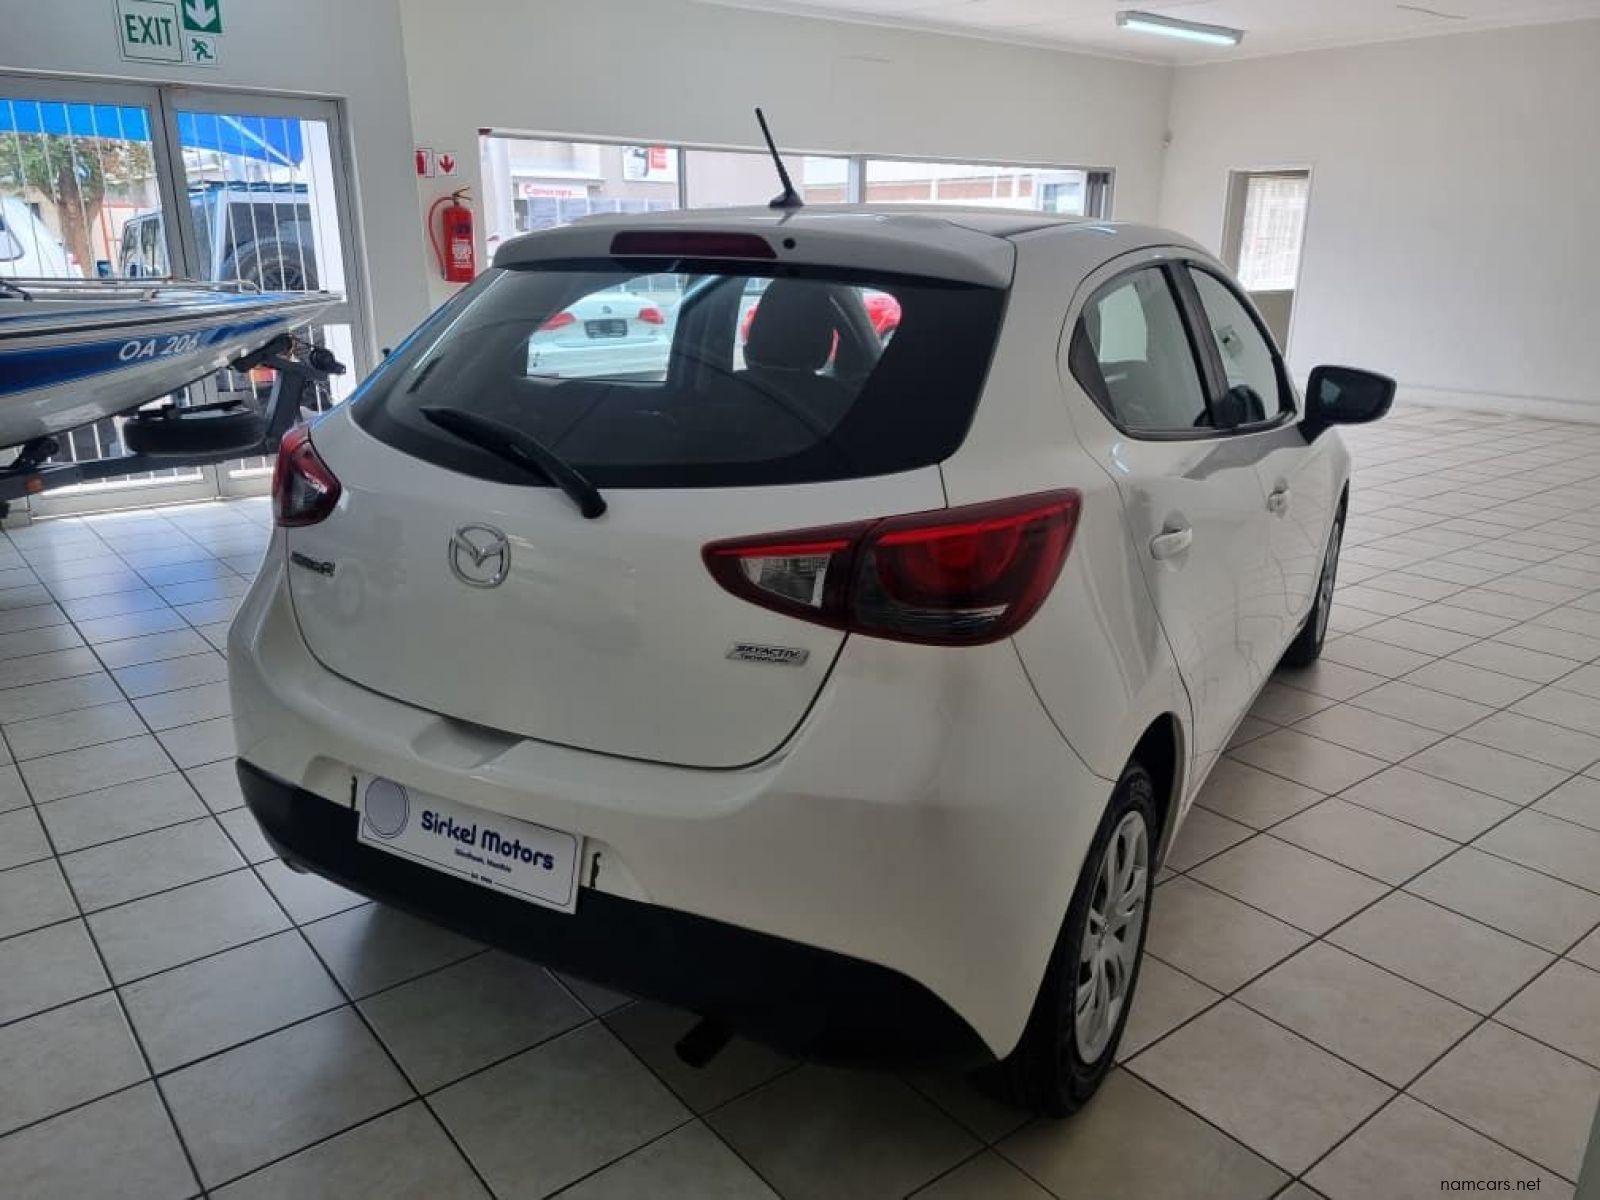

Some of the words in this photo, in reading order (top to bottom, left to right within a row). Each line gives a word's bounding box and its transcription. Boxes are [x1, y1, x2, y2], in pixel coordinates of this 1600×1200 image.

[125, 14, 172, 47] EXIT
[119, 339, 157, 361] OA
[421, 810, 477, 846] Sirkel
[481, 829, 554, 870] Motors
